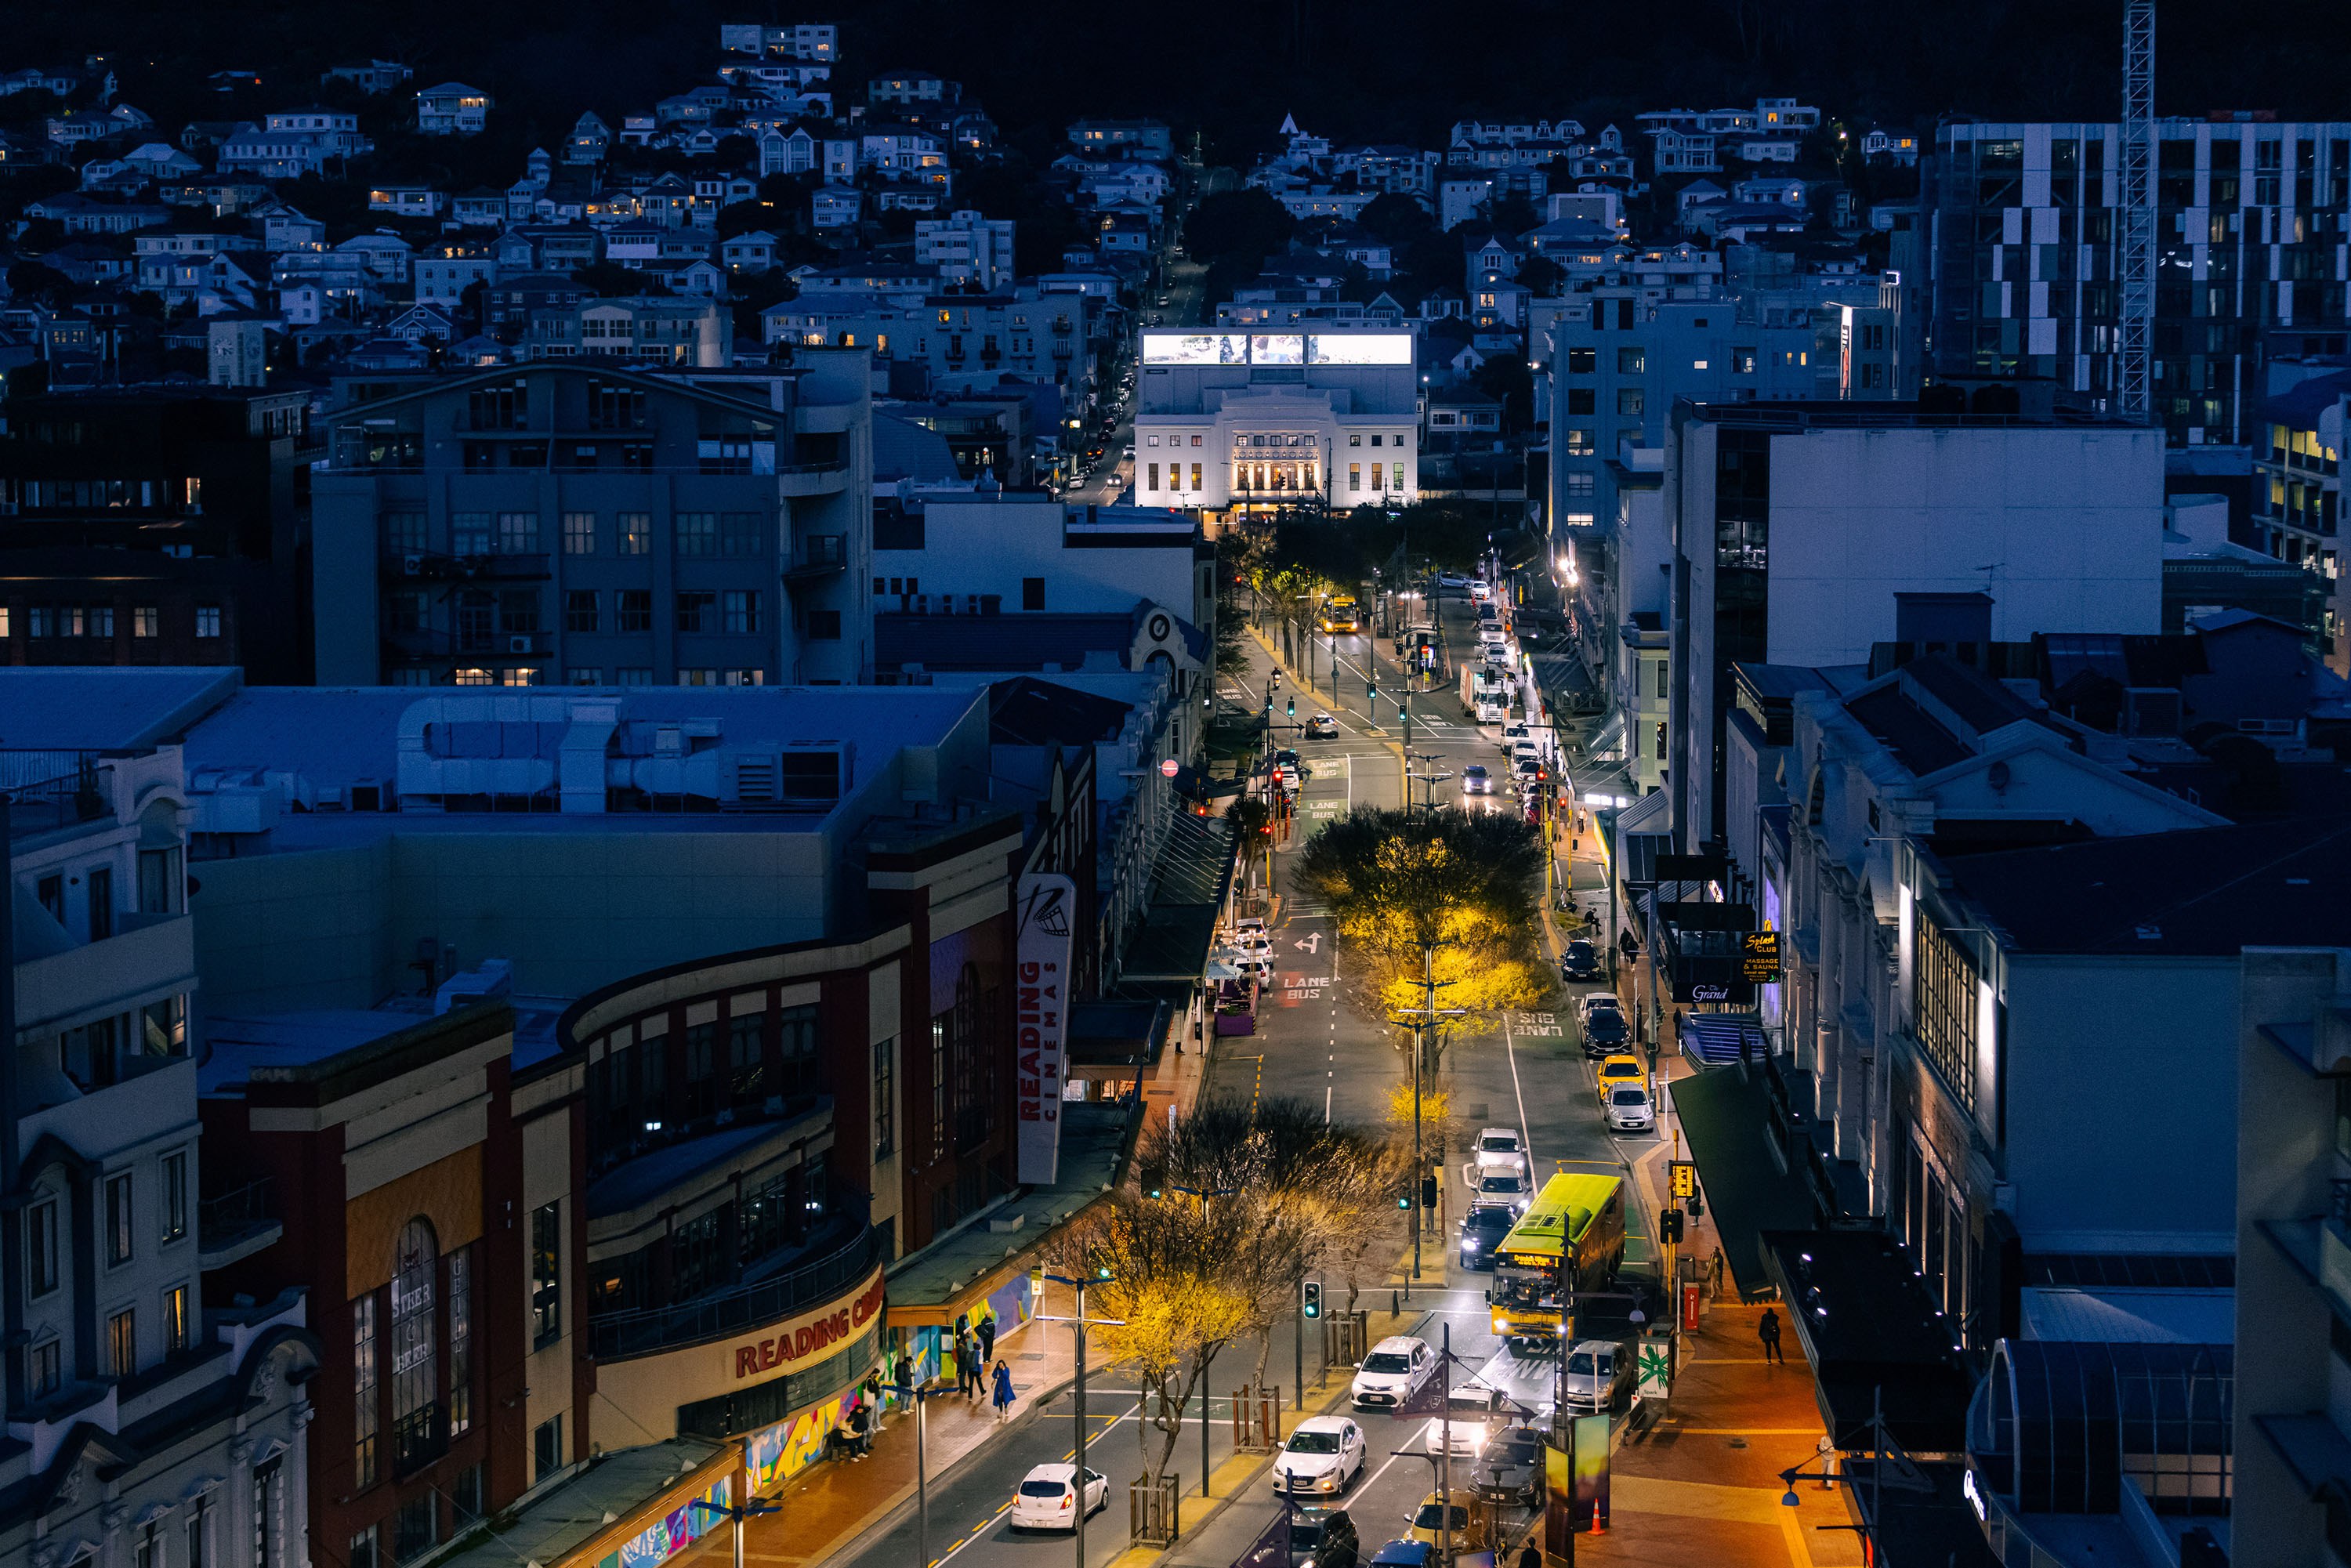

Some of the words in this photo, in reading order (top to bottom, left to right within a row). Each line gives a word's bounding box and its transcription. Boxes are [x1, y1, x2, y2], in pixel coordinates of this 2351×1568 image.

[1745, 934, 1775, 949] Splash
[1284, 977, 1330, 988] LANE
[1287, 989, 1320, 1000] BUS
[1692, 984, 1730, 1003] Grand
[1519, 1012, 1556, 1024] BUS
[1513, 1025, 1563, 1037] LANE
[1019, 961, 1040, 1121] READING
[1044, 961, 1057, 1122] CINEMAS
[1554, 1257, 1559, 1267] 1
[736, 1308, 849, 1379] READING
